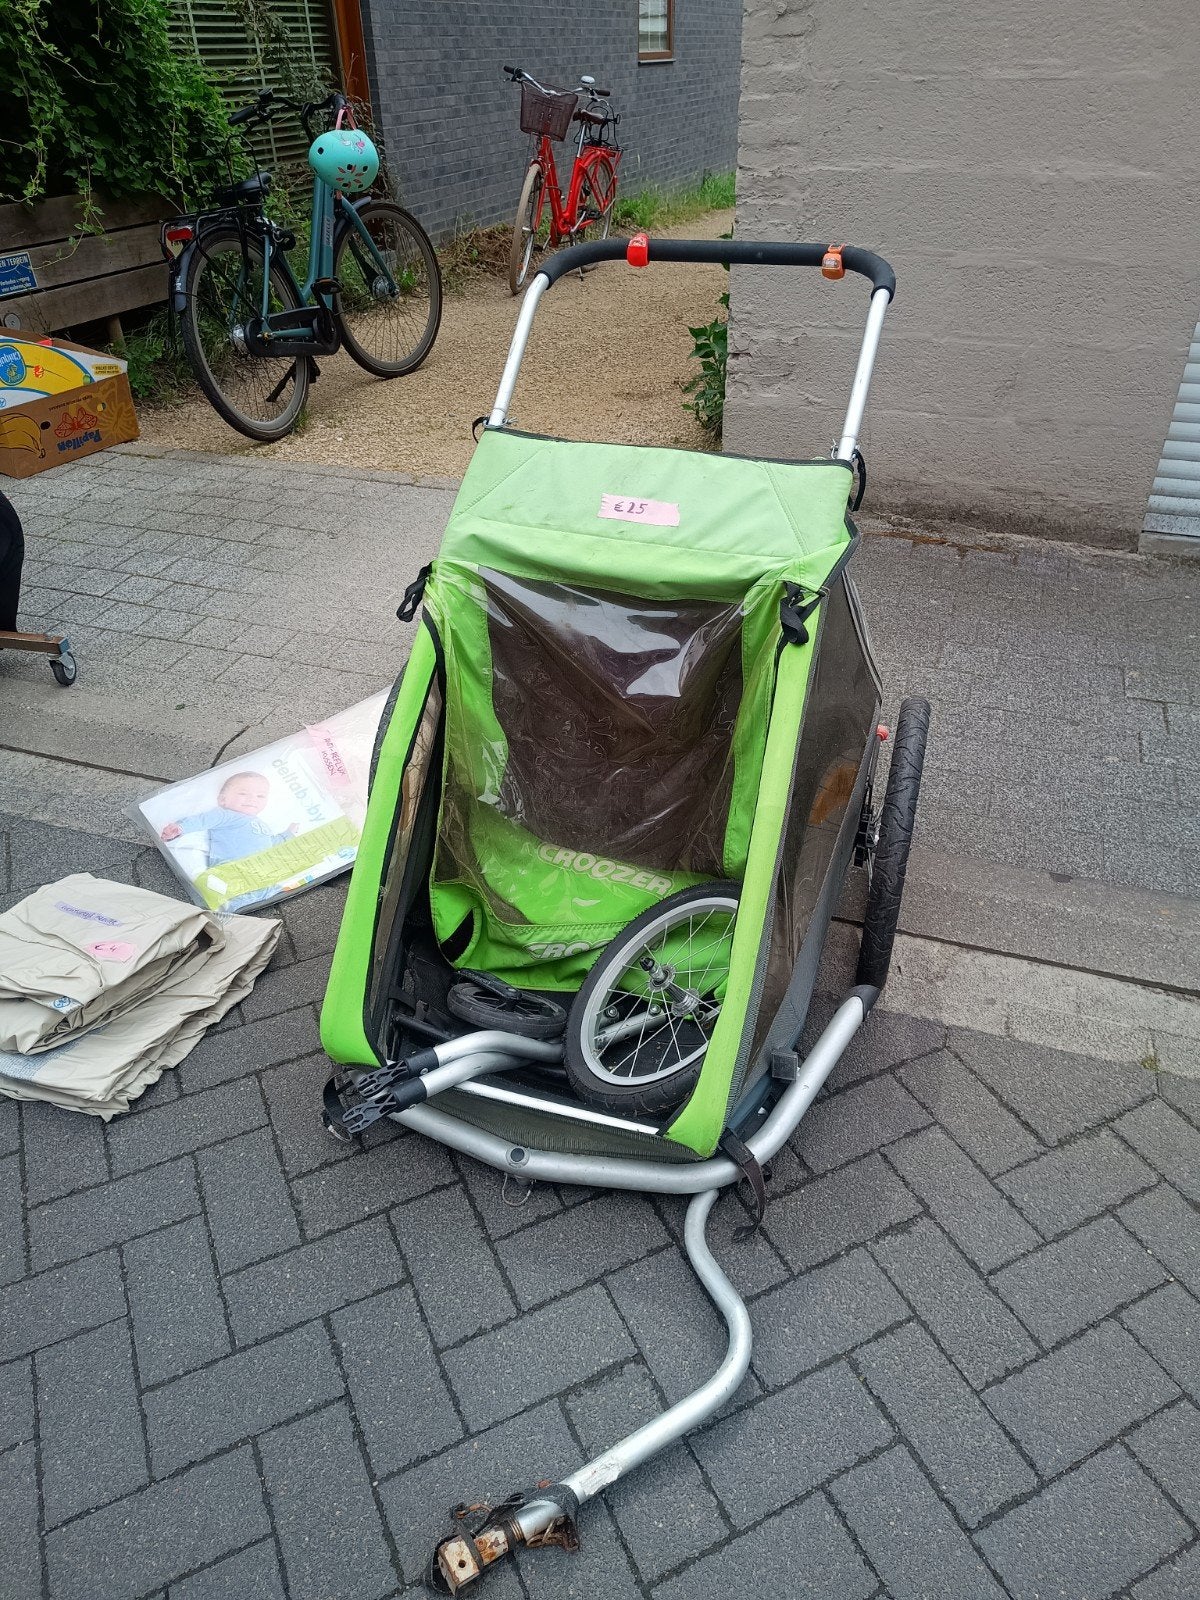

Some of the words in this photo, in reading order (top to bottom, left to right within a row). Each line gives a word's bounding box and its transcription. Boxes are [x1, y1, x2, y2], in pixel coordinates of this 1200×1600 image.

[7, 255, 29, 266] TERREIN
[57, 428, 102, 454] Papillon
[271, 759, 326, 822] deltabby
[538, 842, 672, 896] CROOZER
